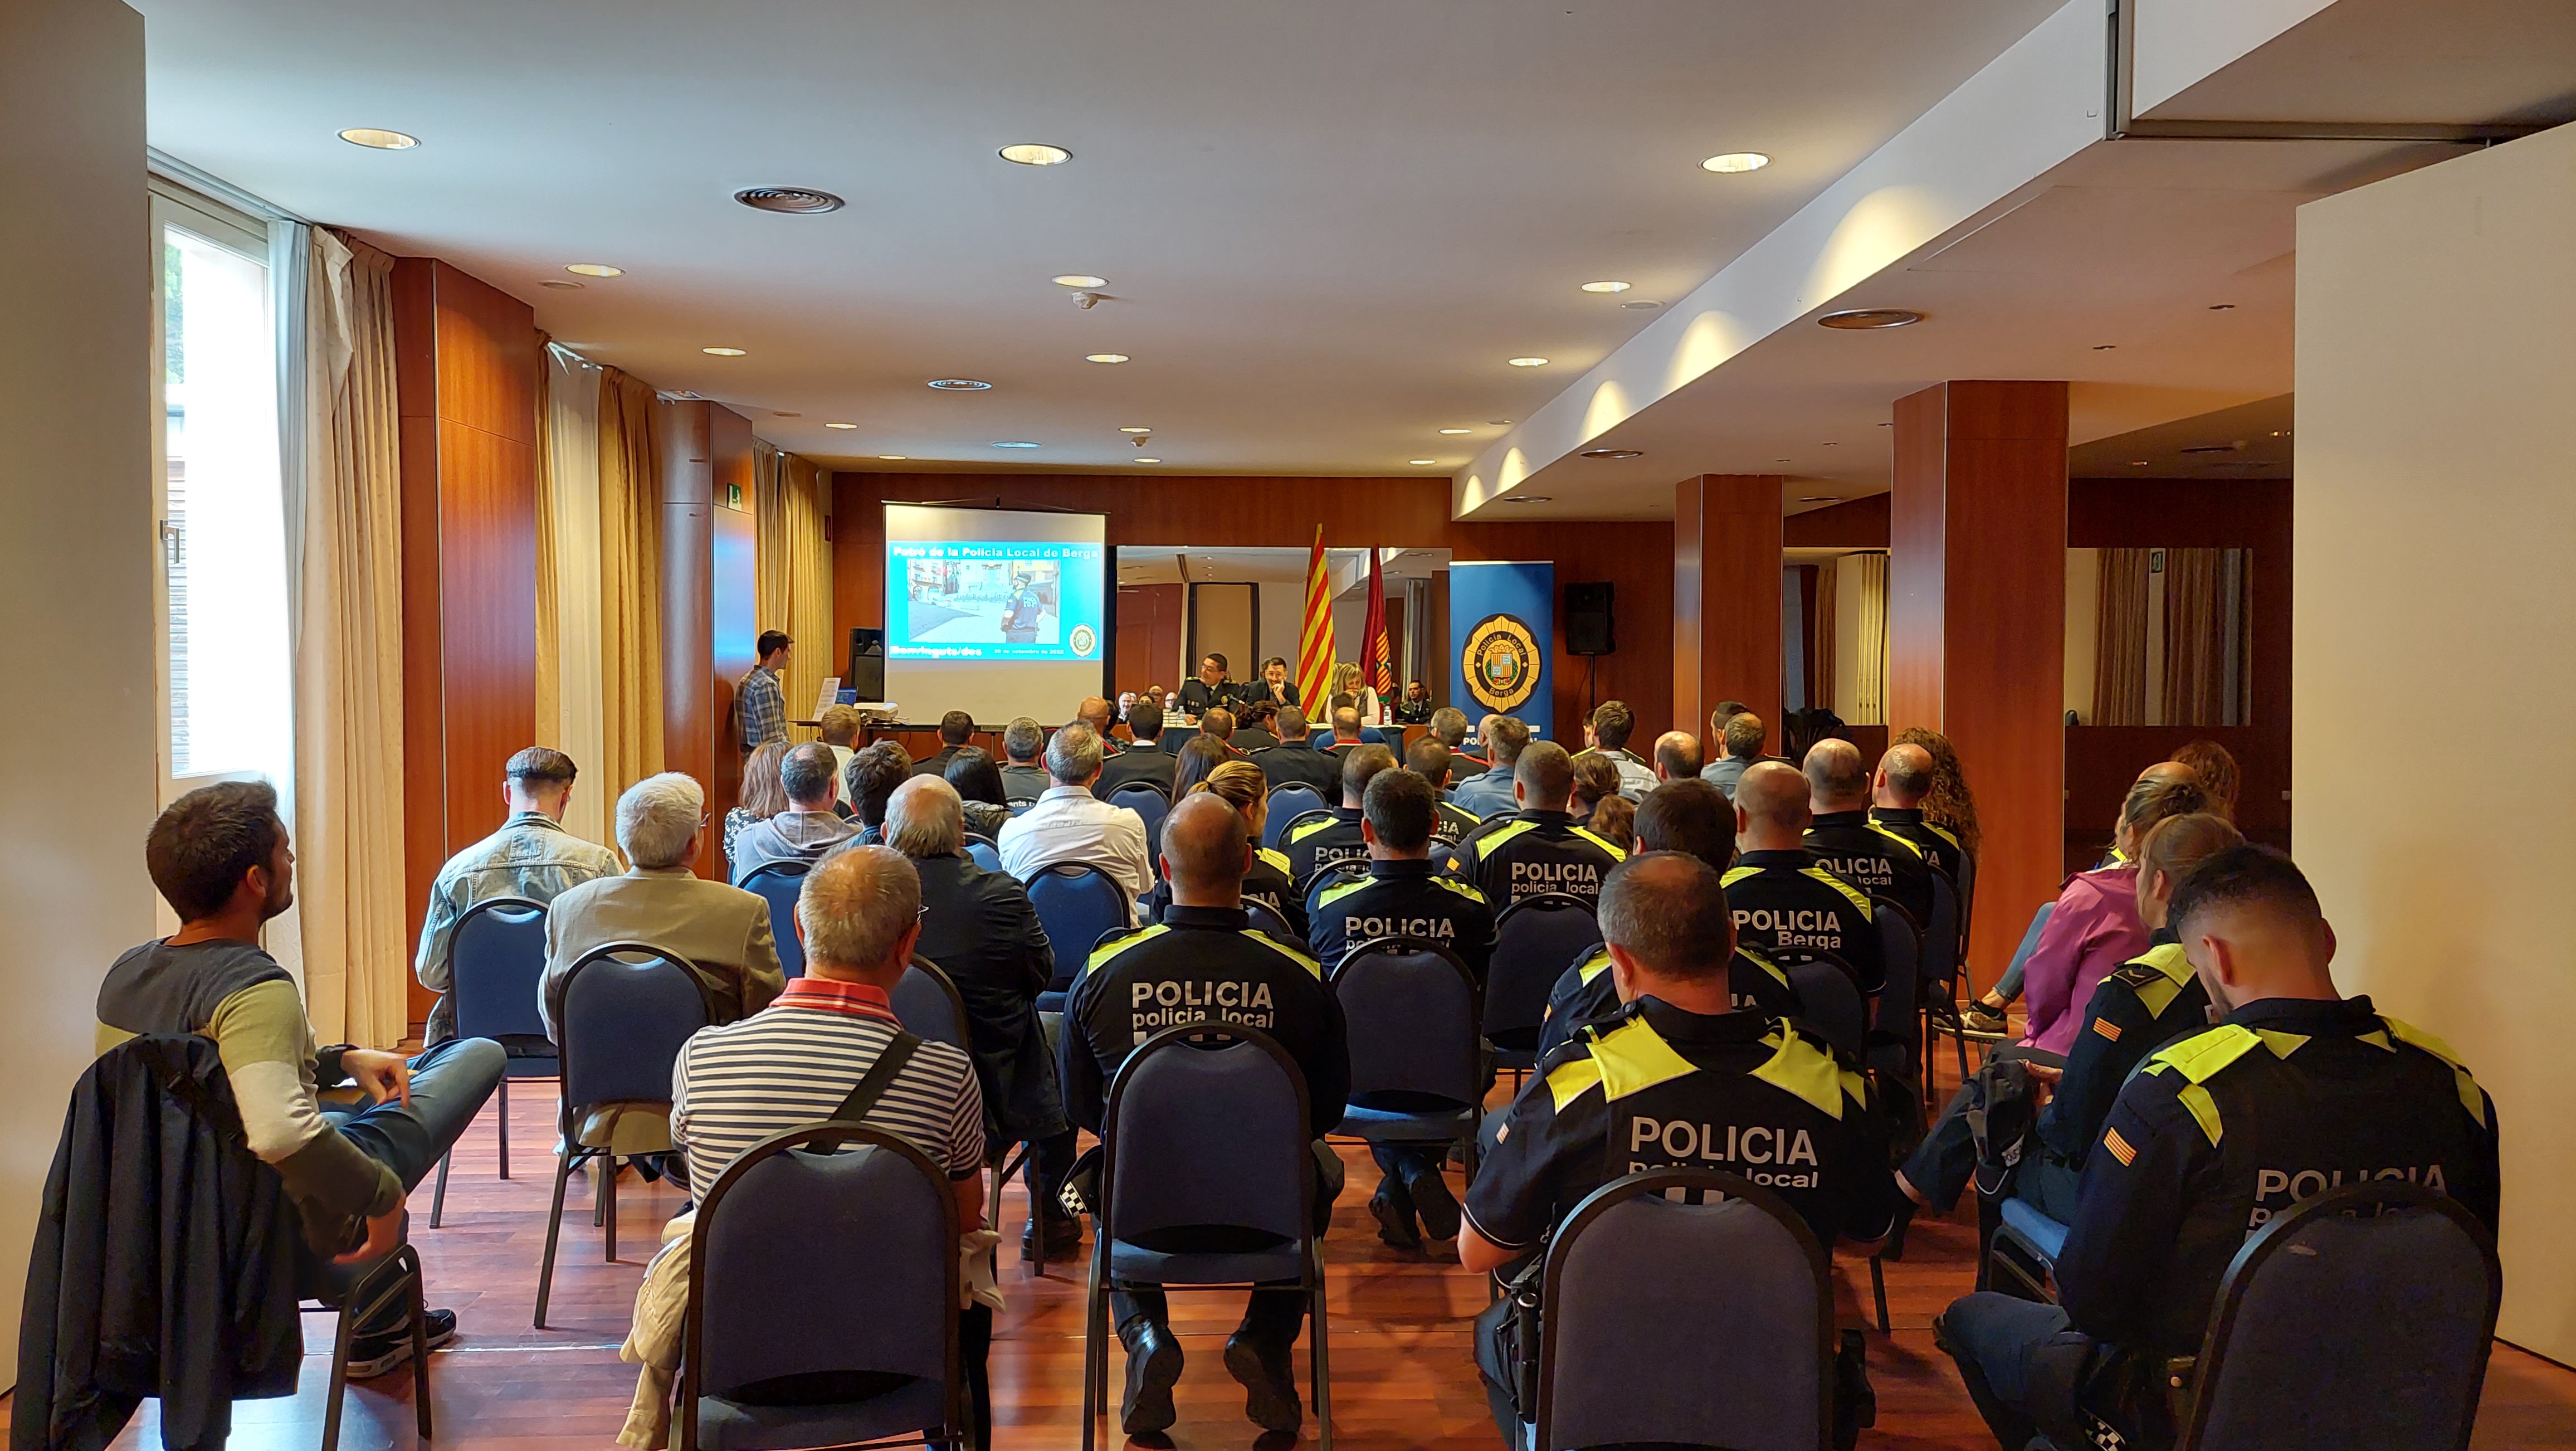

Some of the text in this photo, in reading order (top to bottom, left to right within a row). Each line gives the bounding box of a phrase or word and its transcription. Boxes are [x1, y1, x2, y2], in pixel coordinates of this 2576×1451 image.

[929, 547, 944, 557] de
[948, 547, 959, 557] la
[1007, 548, 1040, 557] Local
[1043, 549, 1058, 557] de
[1062, 548, 1098, 559] Berga
[1477, 634, 1527, 656] Policia Local
[1489, 688, 1514, 697] Berga
[1511, 862, 1598, 882] POLICIA
[1814, 858, 1893, 874] OLICIA
[1511, 880, 1598, 894] policia local
[1857, 875, 1891, 885] local
[1345, 917, 1455, 937] POLICIA
[1732, 910, 1841, 932] POLICIA
[1778, 931, 1841, 950] Berga
[1132, 981, 1274, 1009] POLICIA
[1133, 1007, 1274, 1030] policia local
[1631, 1116, 1818, 1166] POLICIA
[1746, 1168, 1818, 1188] local
